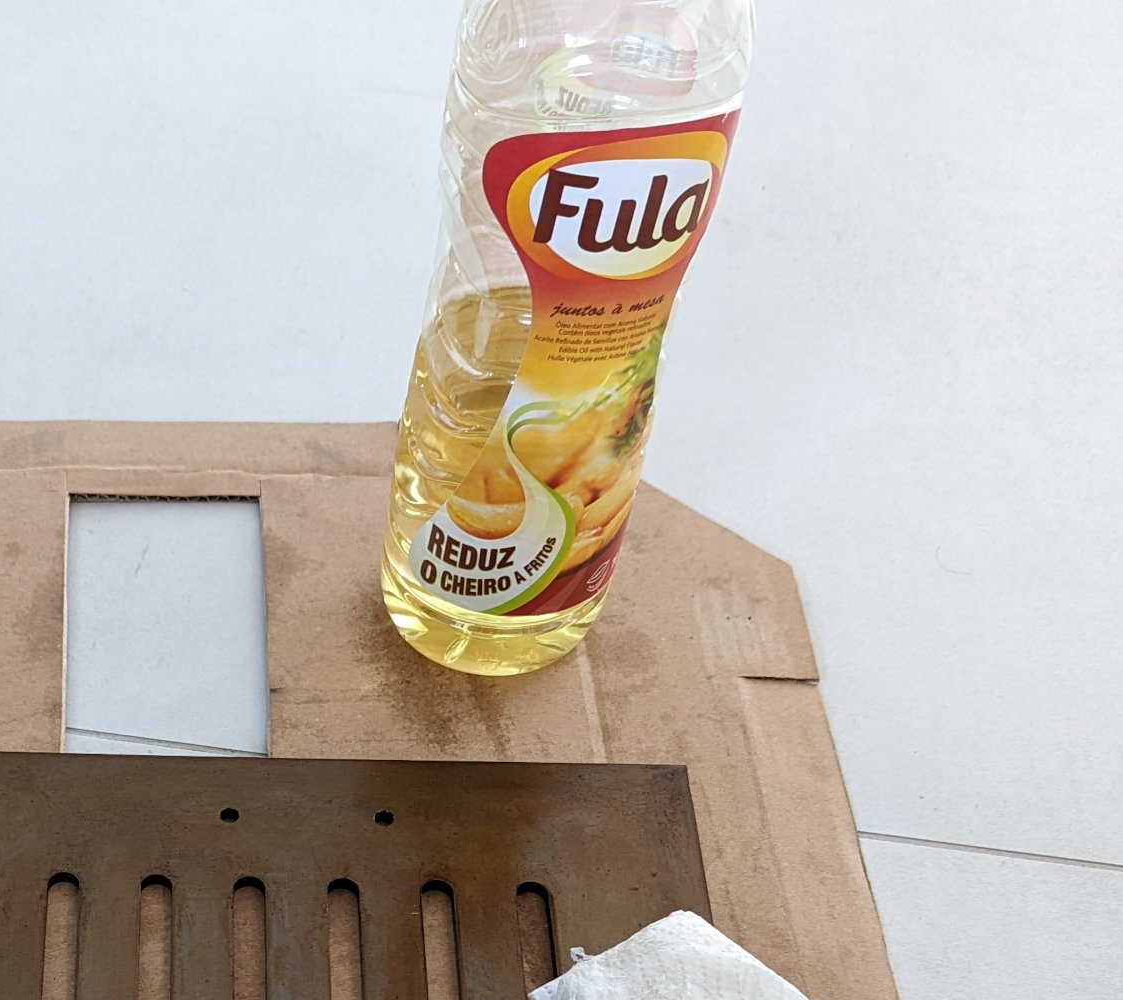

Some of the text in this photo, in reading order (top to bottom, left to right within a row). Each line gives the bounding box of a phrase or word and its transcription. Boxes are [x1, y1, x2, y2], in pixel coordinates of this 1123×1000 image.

[533, 168, 709, 253] Fula
[550, 294, 665, 317] juntos à mesa
[534, 334, 554, 343] Aceite
[547, 354, 565, 362] Huile
[426, 523, 517, 572] REDUZ
[420, 537, 557, 597] O CHEIRO A FRITOS
